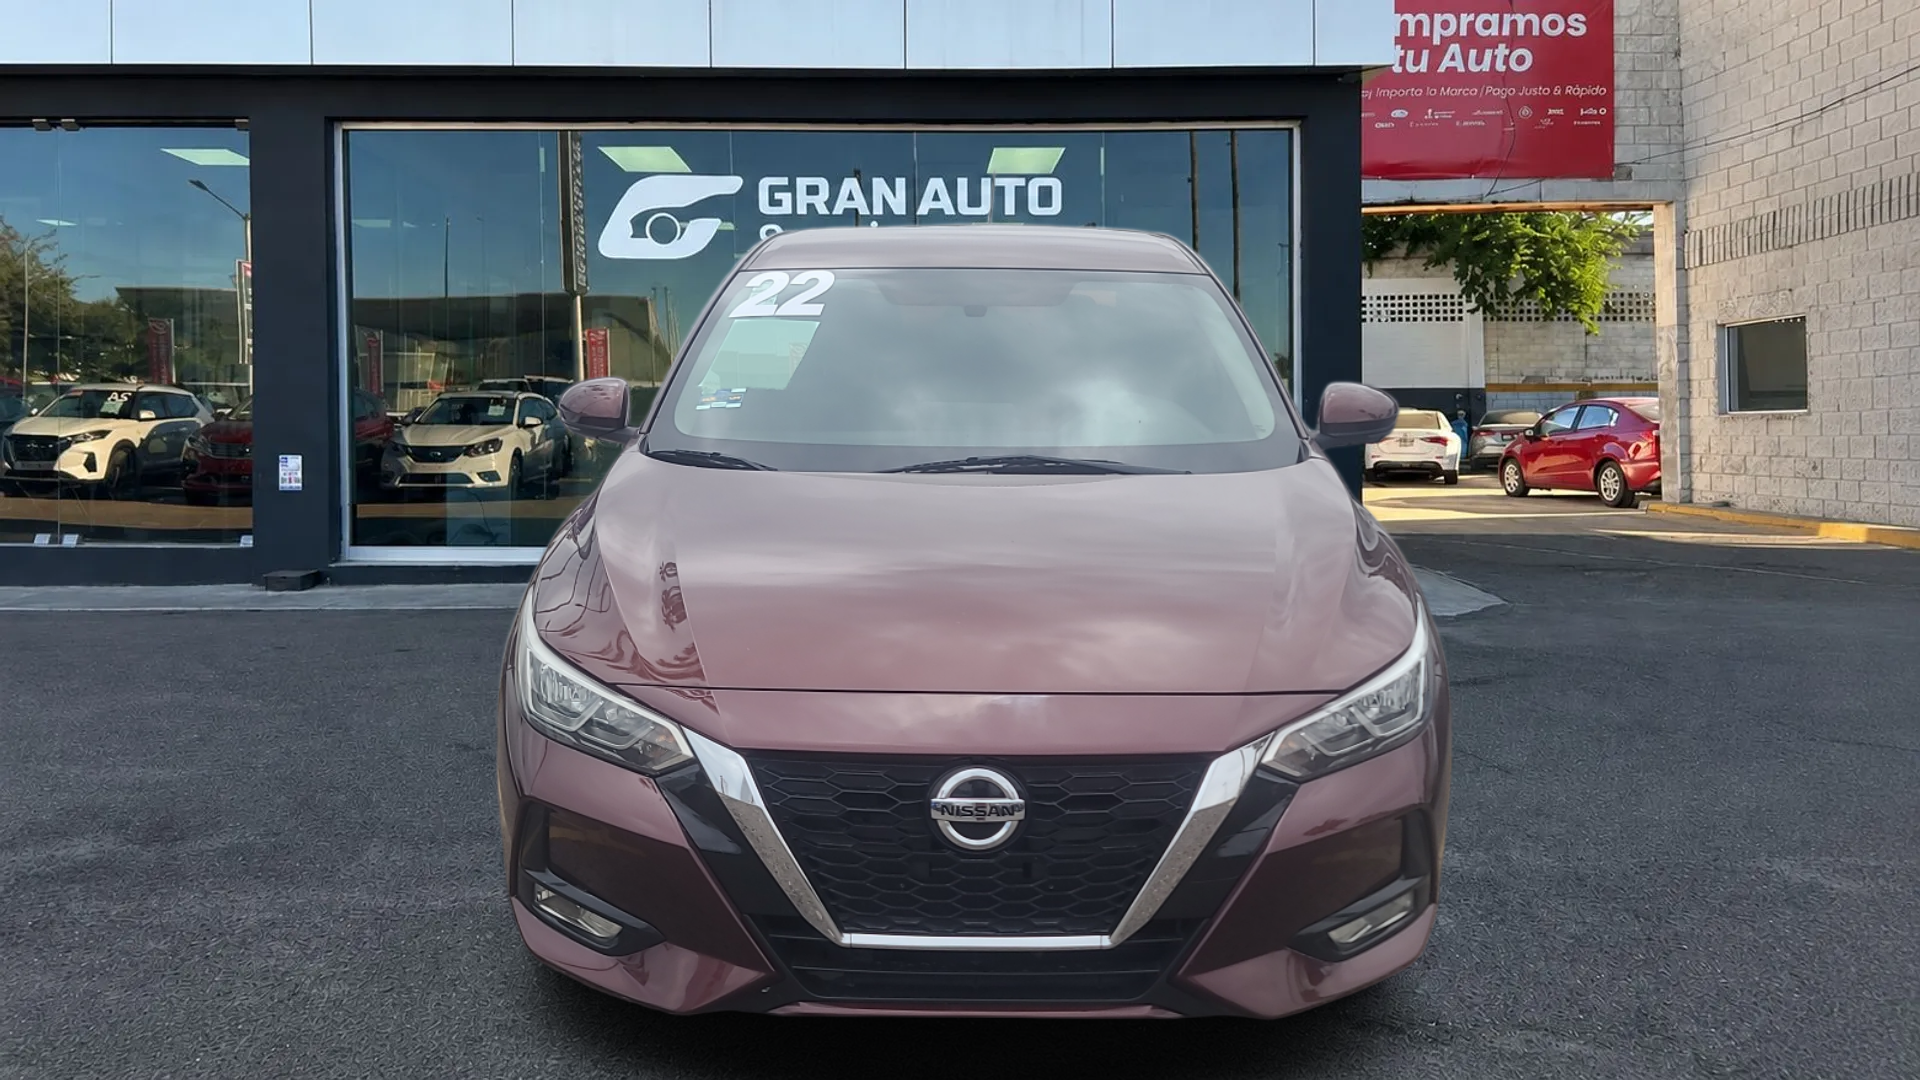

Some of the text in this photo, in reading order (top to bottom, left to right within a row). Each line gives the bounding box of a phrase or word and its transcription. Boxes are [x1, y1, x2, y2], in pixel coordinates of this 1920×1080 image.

[1392, 42, 1534, 73] tu Auto
[1519, 85, 1551, 97] Justo
[758, 176, 1062, 216] GRAN AUTO
[728, 269, 836, 318] 22
[940, 803, 1015, 817] NISSAN
